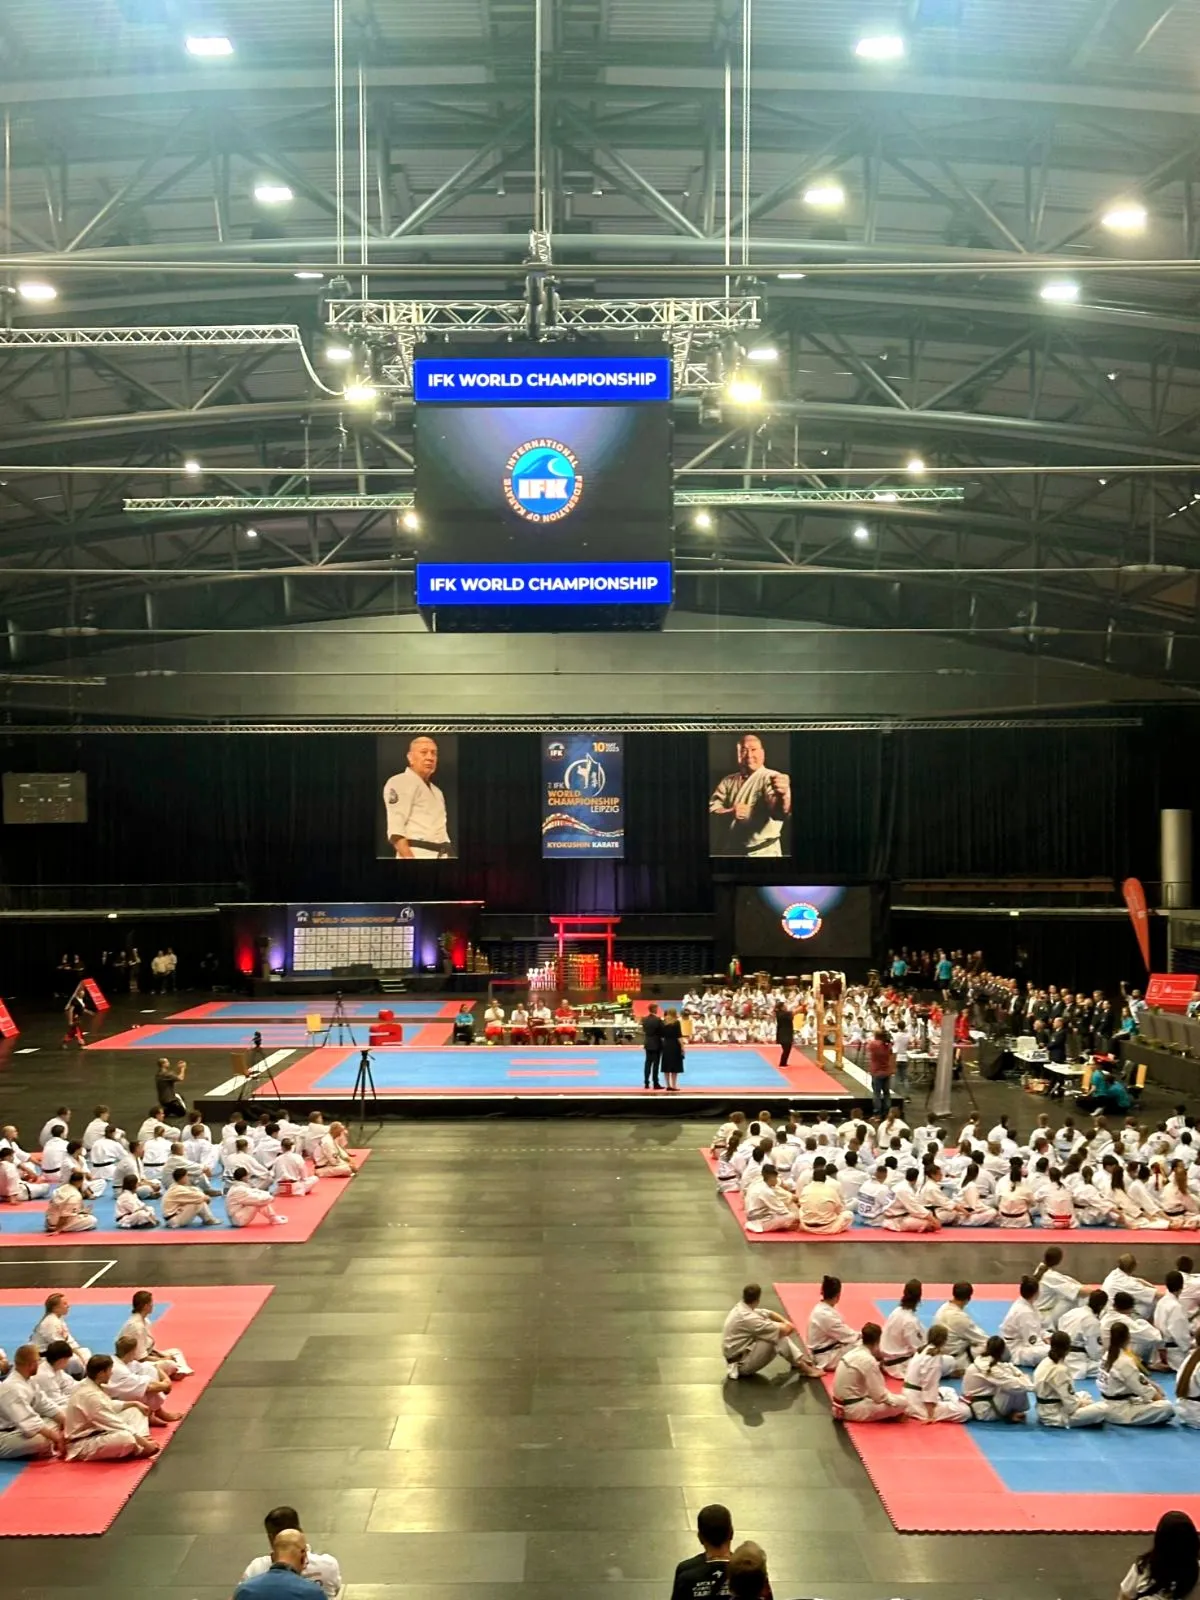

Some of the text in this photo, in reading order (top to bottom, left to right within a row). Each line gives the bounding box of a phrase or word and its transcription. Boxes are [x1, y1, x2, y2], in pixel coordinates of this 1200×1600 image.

[428, 372, 656, 387] IFK WORLD CHAMPIONSHIP
[505, 439, 578, 470] INTERNATIONAL
[518, 478, 568, 499] IFK
[503, 475, 583, 523] FEDERATION OF KARATE
[430, 576, 658, 592] IFK WORLD CHAMPIONSHIP
[592, 742, 606, 752] 10
[548, 797, 620, 806] CHAMPIONSHIP
[590, 805, 620, 813] LEIPZIG
[547, 841, 591, 849] KYOKUSHIN
